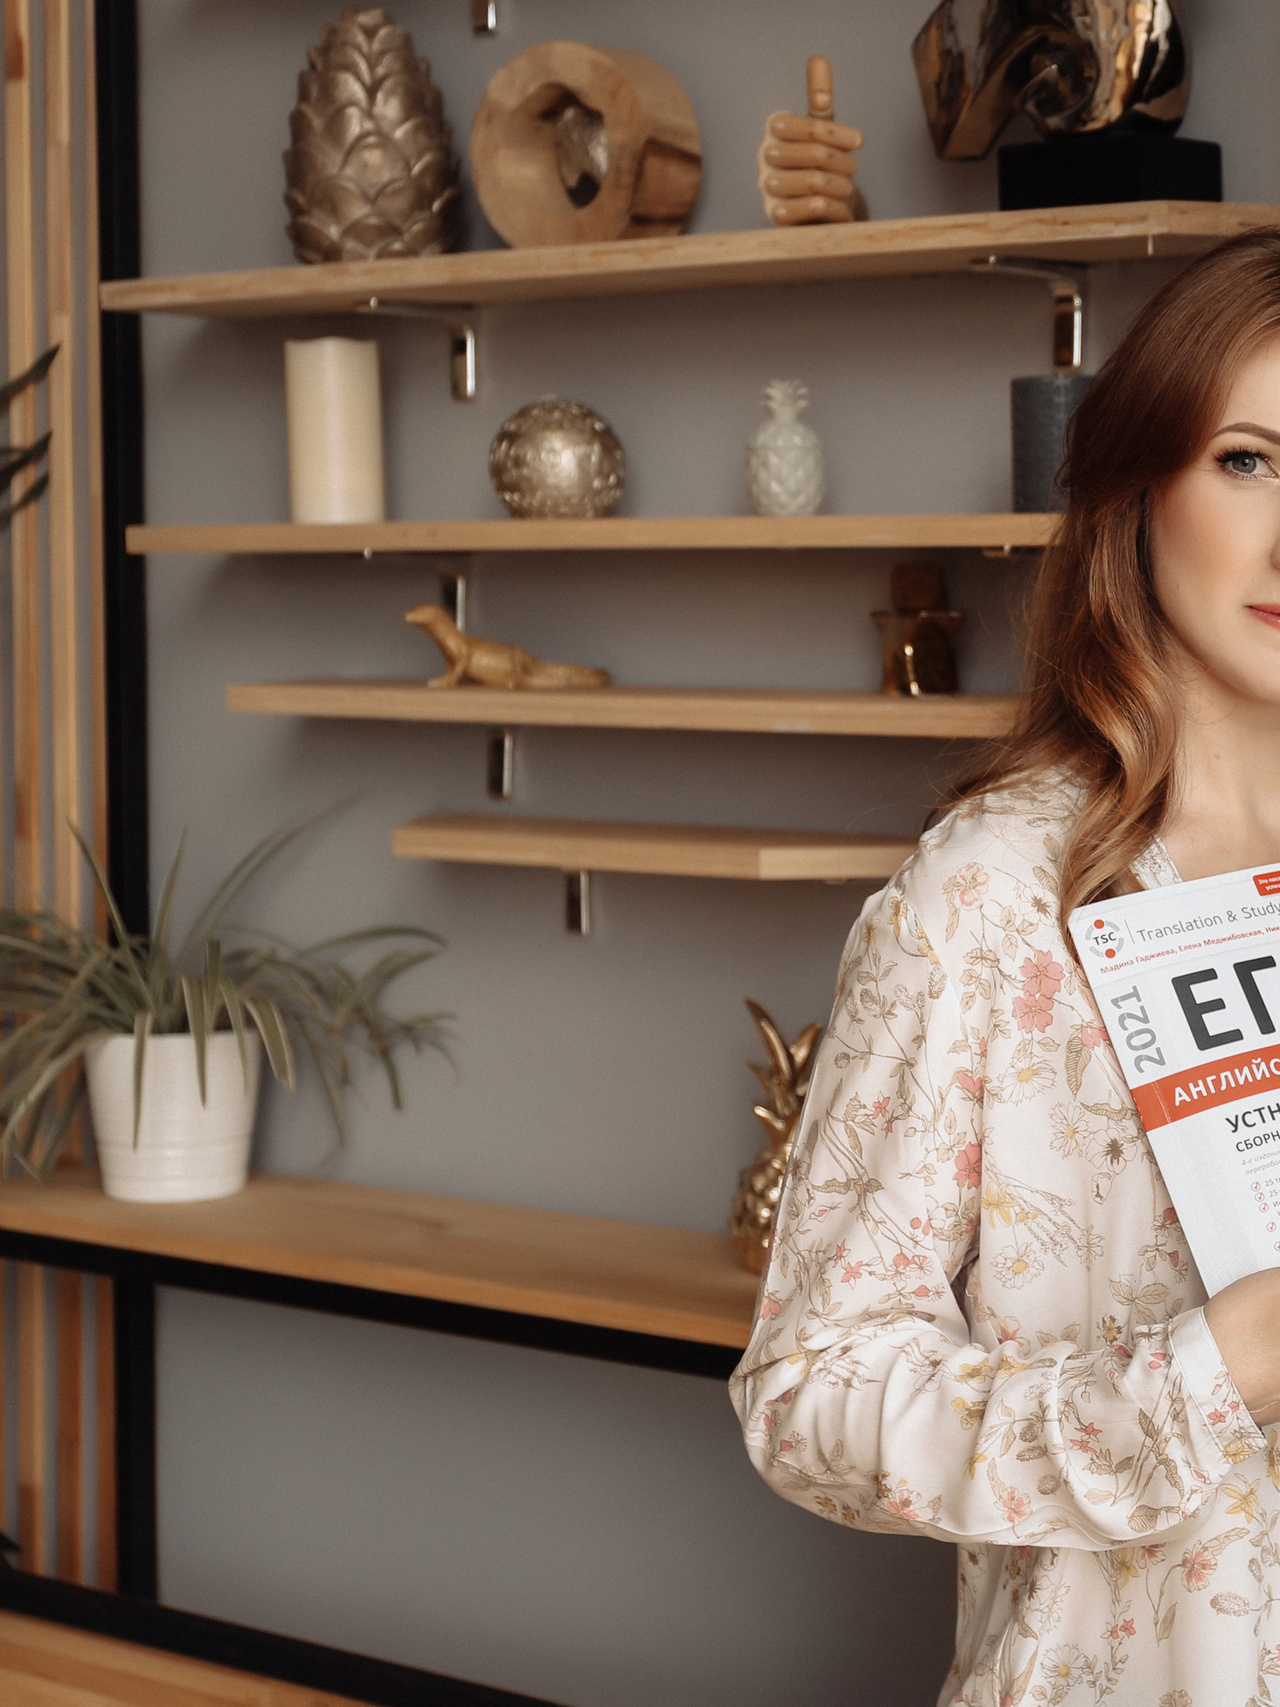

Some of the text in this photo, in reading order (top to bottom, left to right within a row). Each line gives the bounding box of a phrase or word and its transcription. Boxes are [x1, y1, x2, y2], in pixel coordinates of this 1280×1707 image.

[1136, 915, 1223, 942] Translation
[1226, 910, 1238, 923] &
[1093, 932, 1117, 946] TSC
[1100, 960, 1134, 974] Мадина
[1135, 949, 1178, 963] Гаджиева,
[1178, 942, 1202, 952] Елена
[1110, 985, 1166, 1073] 2021
[1265, 1179, 1274, 1187] 25
[1268, 1189, 1279, 1197] 25
